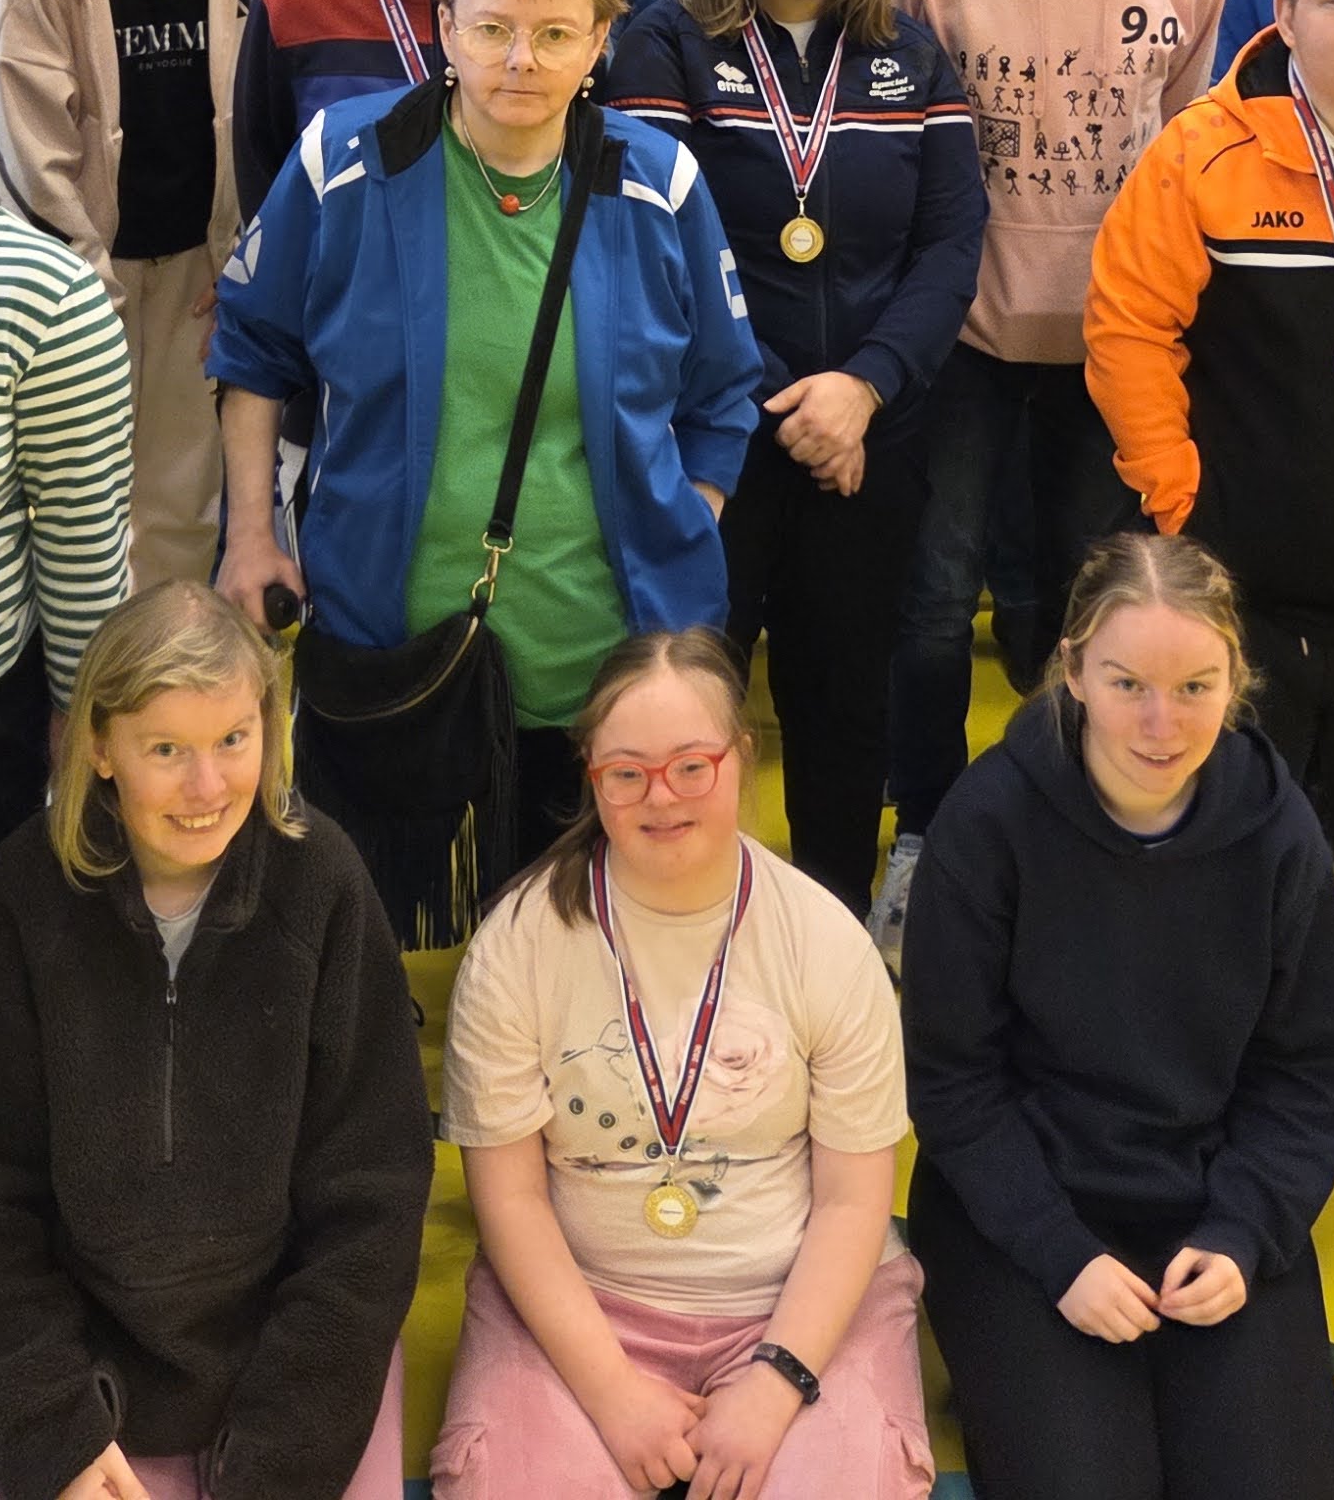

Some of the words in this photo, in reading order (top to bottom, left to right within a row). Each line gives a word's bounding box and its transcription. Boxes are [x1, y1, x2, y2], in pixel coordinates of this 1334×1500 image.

[116, 20, 206, 58] EMM
[1121, 5, 1179, 46] 9.a
[1251, 210, 1305, 229] JAKO
